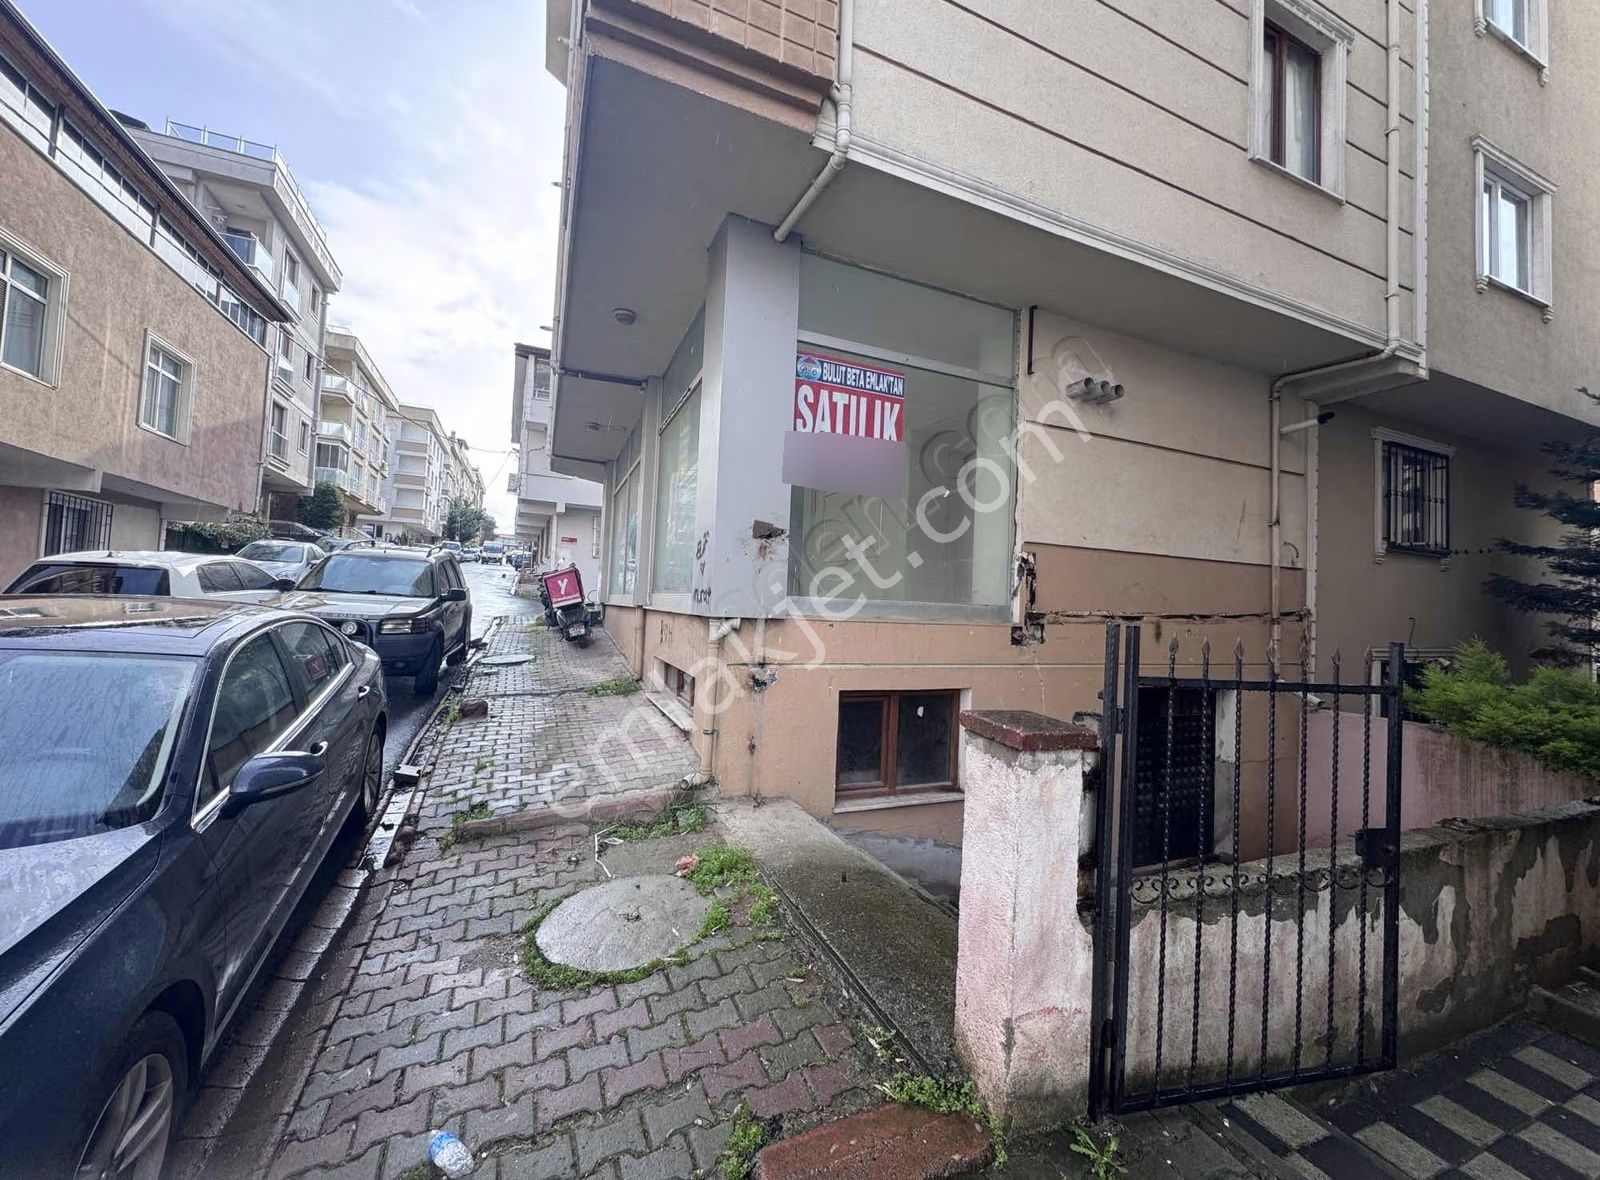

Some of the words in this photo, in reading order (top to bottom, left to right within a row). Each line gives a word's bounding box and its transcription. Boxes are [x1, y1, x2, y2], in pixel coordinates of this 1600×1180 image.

[822, 362, 846, 384] BULUT
[846, 367, 865, 388] BETA
[865, 371, 904, 396] EMLAK'TAN
[796, 384, 900, 442] SATILIK
